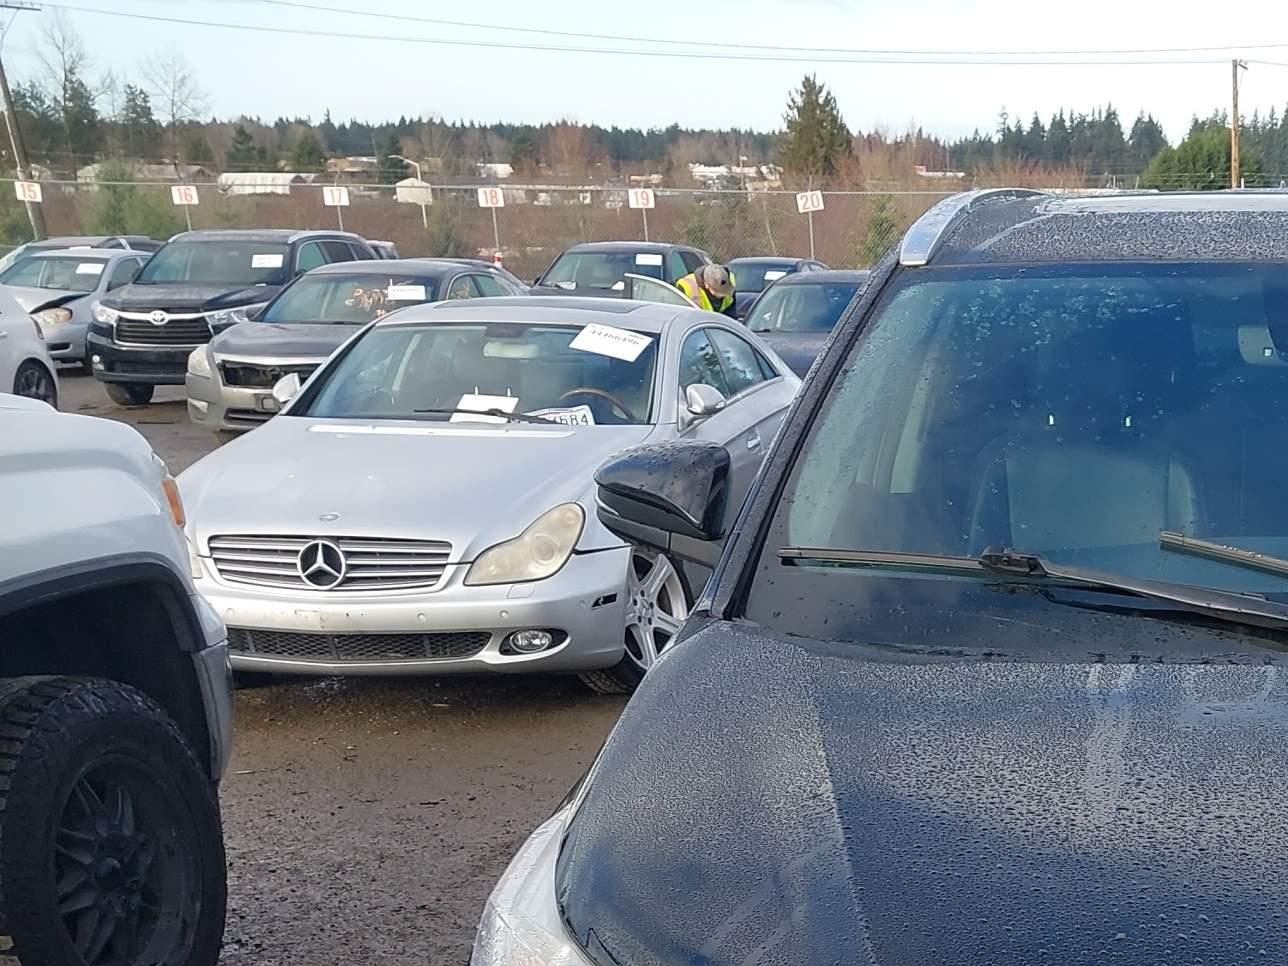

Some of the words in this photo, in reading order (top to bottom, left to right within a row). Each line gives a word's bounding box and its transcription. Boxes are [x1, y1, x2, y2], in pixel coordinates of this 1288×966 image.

[21, 183, 37, 200] 15
[177, 186, 194, 204] 16
[329, 187, 344, 204] 17
[483, 189, 499, 206] 18
[634, 190, 650, 207] 19
[799, 193, 820, 210] 20
